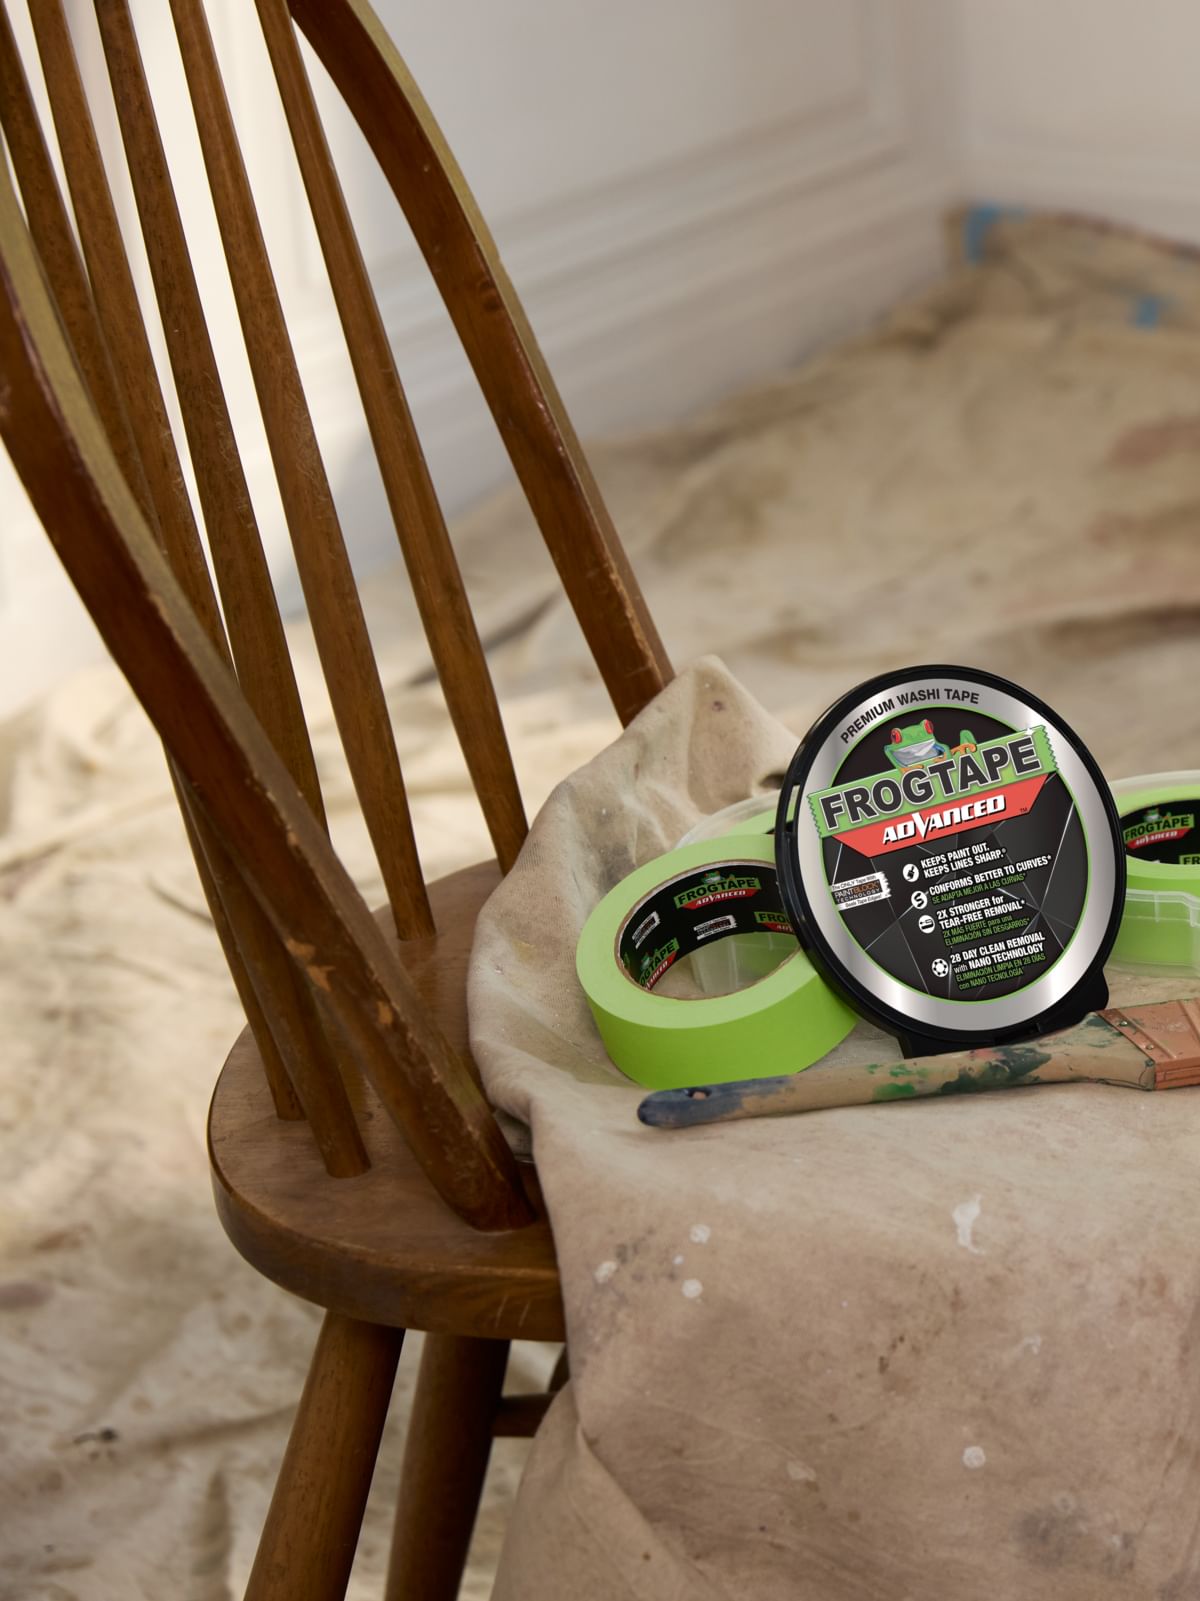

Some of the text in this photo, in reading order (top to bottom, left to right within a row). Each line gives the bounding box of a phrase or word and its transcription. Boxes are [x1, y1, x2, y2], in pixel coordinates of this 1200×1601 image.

[840, 688, 980, 744] PREMIUM WASHI TAPE
[819, 736, 1041, 830] FROGTAPE
[882, 794, 1006, 844] ADVANCED
[1124, 816, 1190, 841] FROGTAPE
[920, 842, 990, 869] KEEPS PAINT OUT.
[923, 864, 950, 878] KEEPS
[950, 857, 974, 871] LINES
[677, 879, 757, 905] FROGTAPE
[929, 876, 974, 896] CONFORMS
[973, 867, 1003, 884] BETTER
[1003, 864, 1015, 875] TO
[932, 896, 939, 904] SE
[940, 889, 964, 902] ADAPTA
[964, 884, 984, 897] MEJOR
[989, 879, 1001, 889] LAS
[695, 889, 746, 906] ADVANCED
[936, 895, 1004, 920] 2X STRONGER for
[939, 911, 983, 930] TEAR-FREE
[943, 930, 951, 938] 2X
[965, 921, 987, 934] FUERTE
[987, 918, 1001, 928] para
[1001, 915, 1013, 923] una
[982, 928, 993, 937] SIN
[950, 931, 1046, 963] 28 DAY CLEAN REMOVAL
[953, 942, 1044, 974] with NANO TECHNOLOGY
[640, 942, 675, 985] OGTAPE
[993, 961, 1014, 973] LIMPIA
[959, 982, 970, 990] con
[970, 977, 987, 987] NANO
